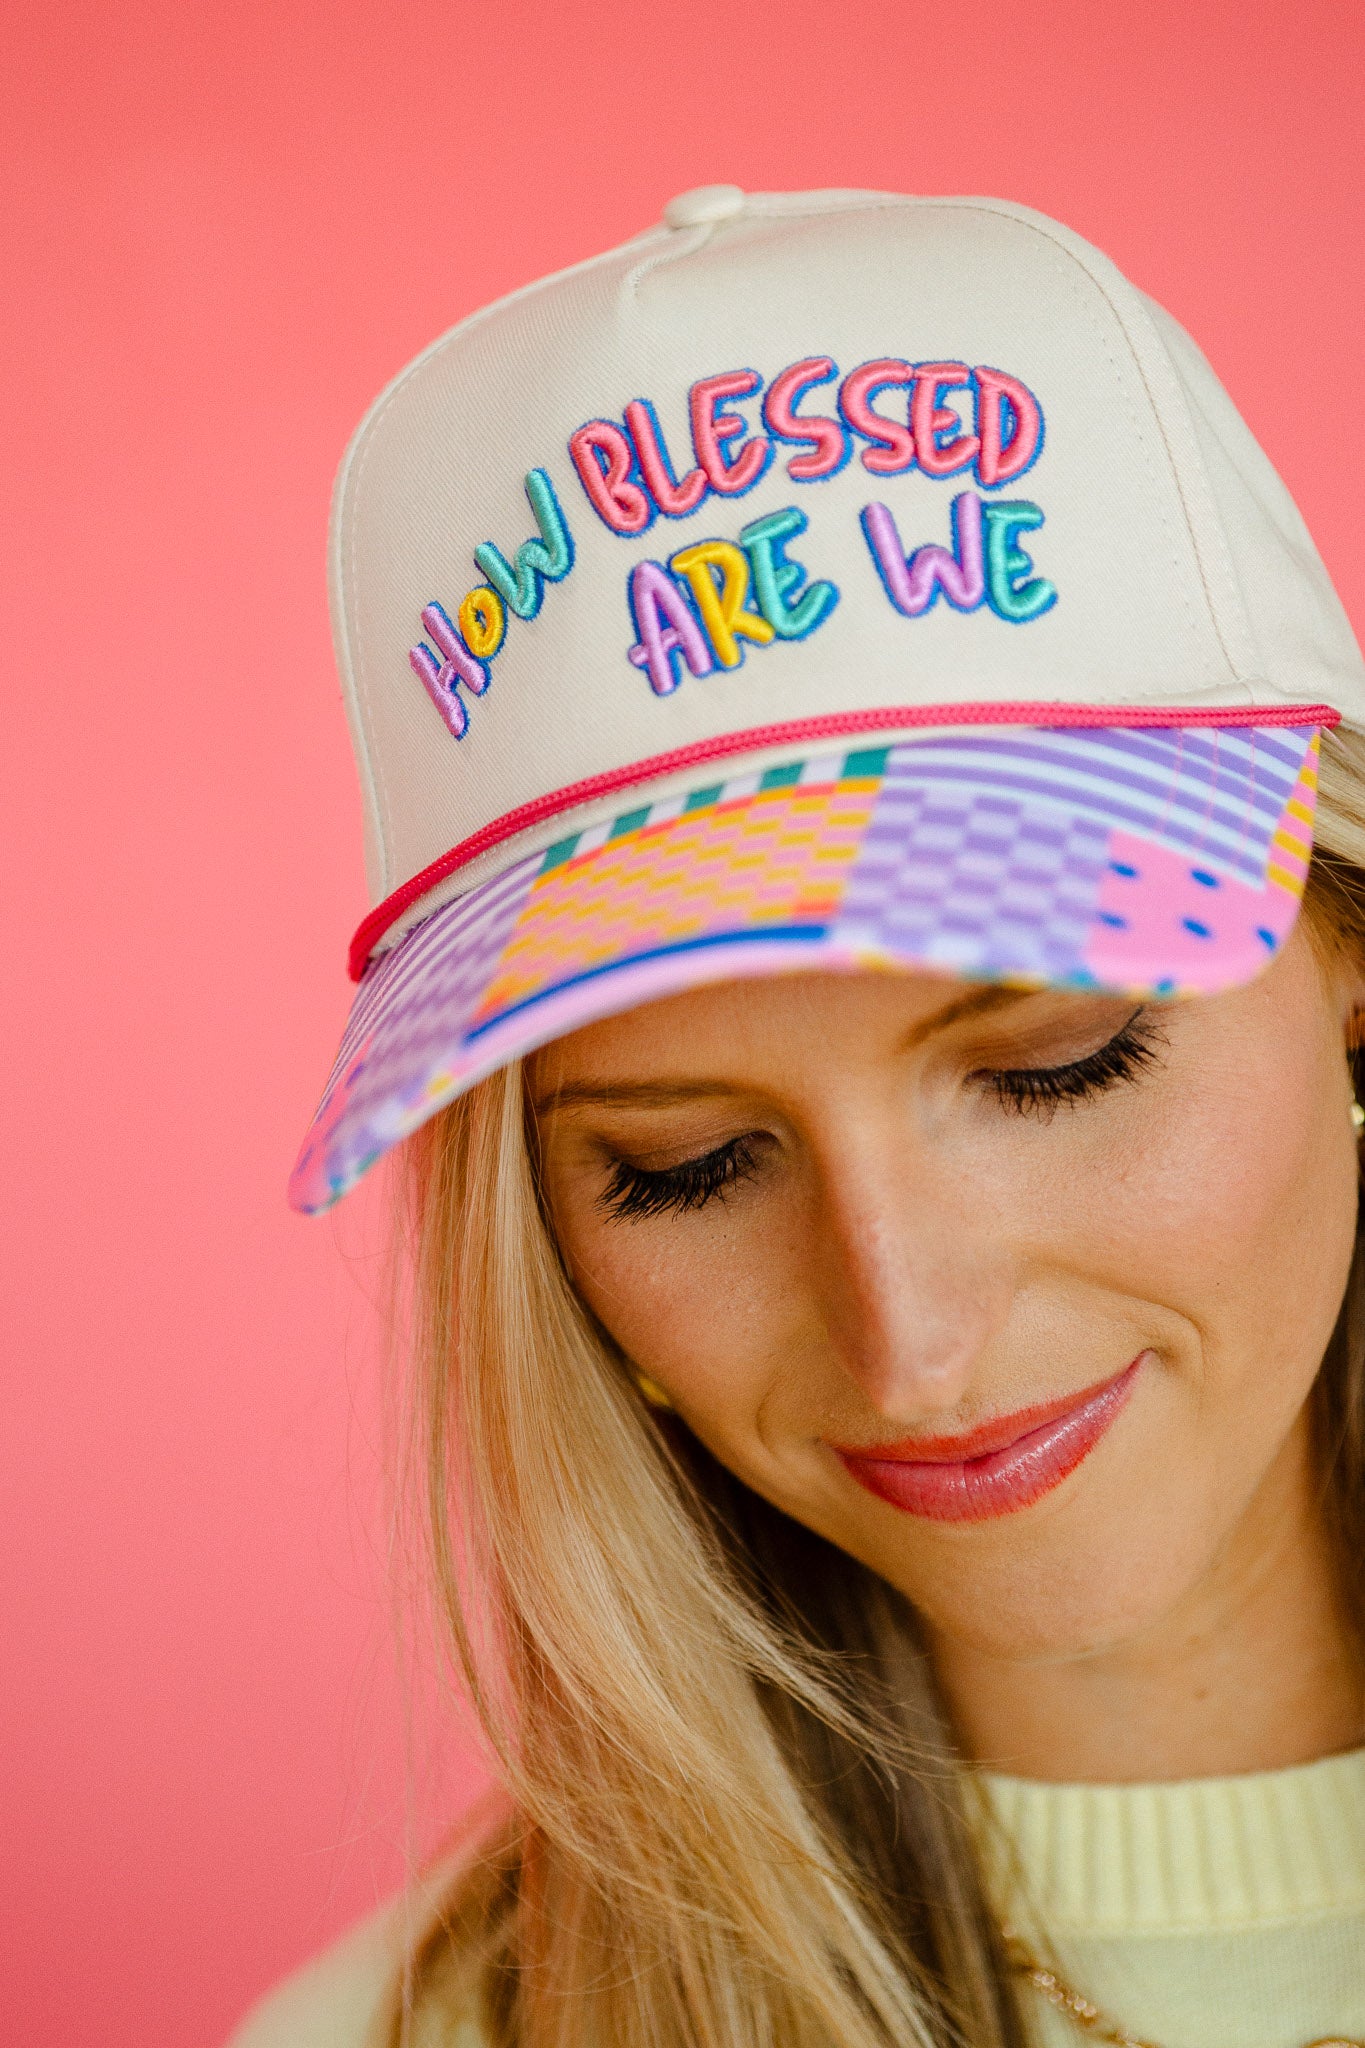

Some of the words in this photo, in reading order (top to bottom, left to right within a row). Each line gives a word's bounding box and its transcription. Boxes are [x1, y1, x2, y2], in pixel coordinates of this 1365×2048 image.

[569, 356, 1045, 537] BLESSED
[627, 506, 840, 696] ARE
[860, 491, 1059, 624] WE
